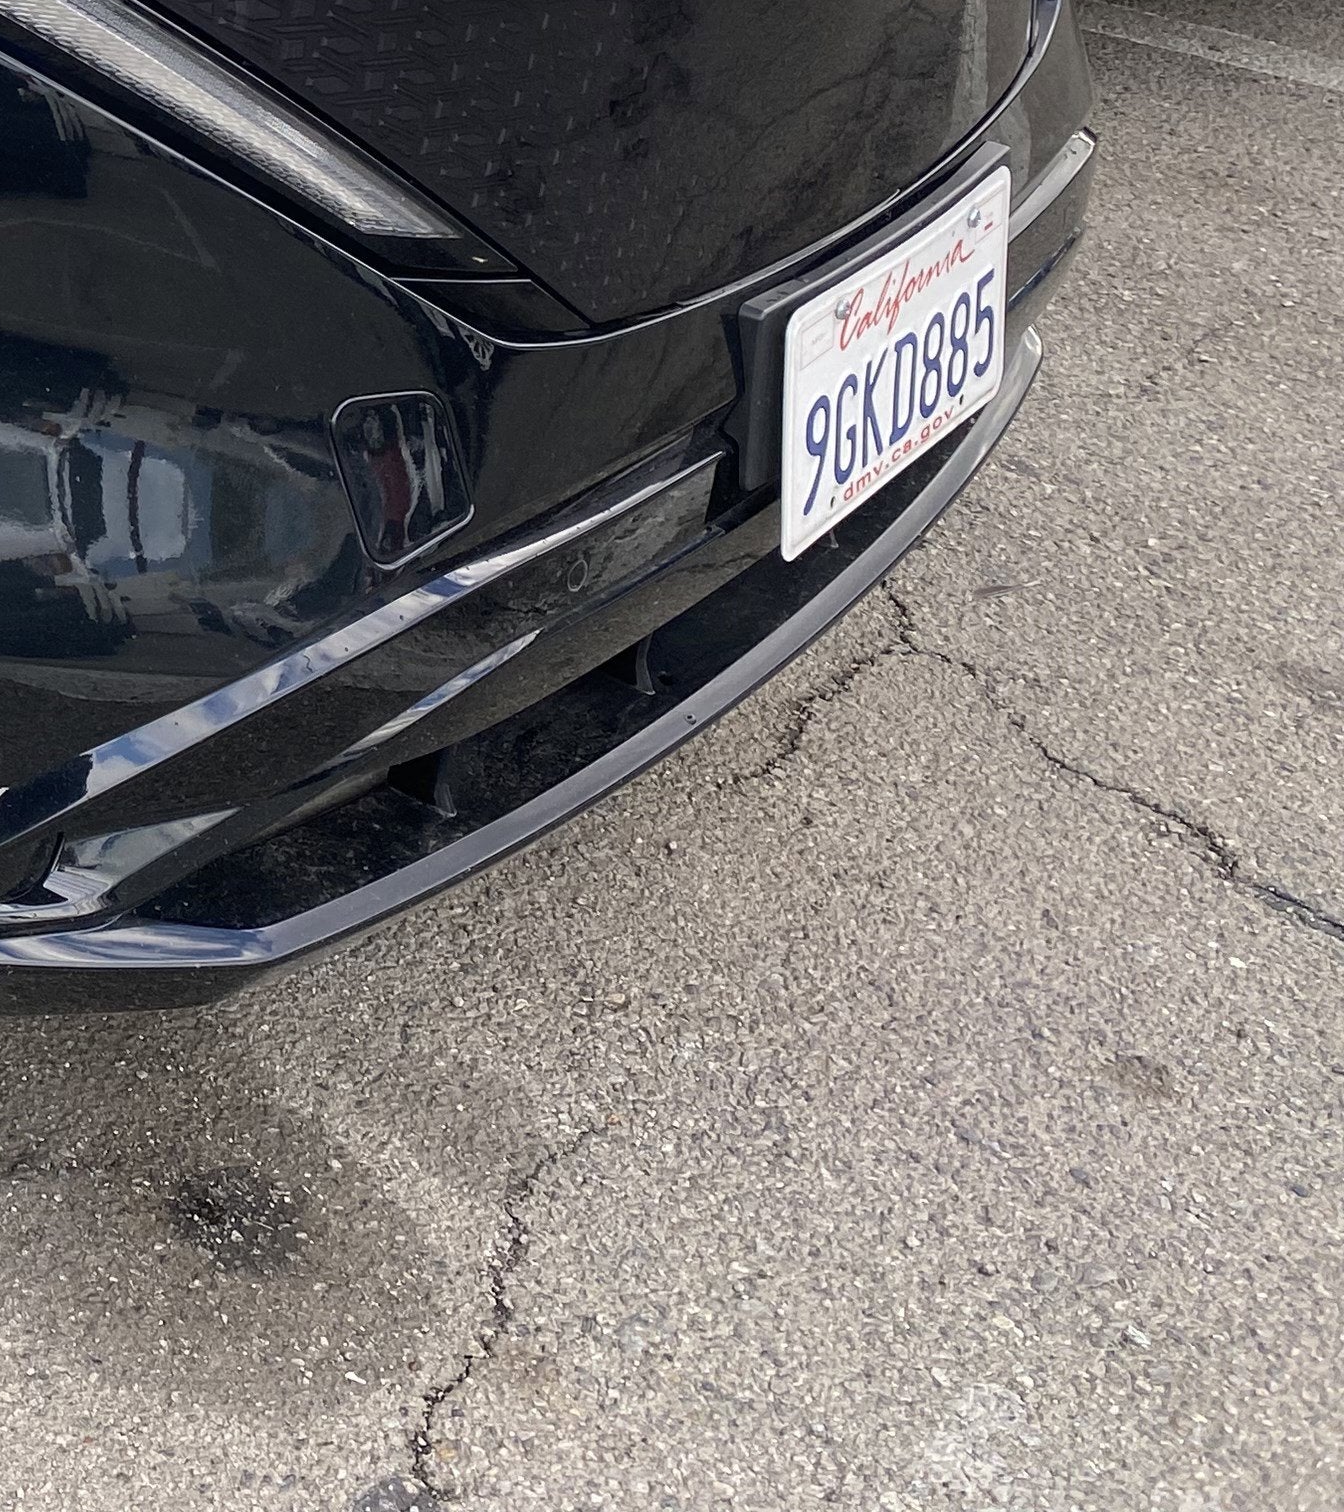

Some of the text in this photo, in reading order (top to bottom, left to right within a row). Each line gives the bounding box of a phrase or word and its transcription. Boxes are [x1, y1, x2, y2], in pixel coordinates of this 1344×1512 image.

[839, 238, 975, 351] California
[803, 267, 995, 516] 9GKD885
[842, 405, 957, 503] dmv.ca.gov
